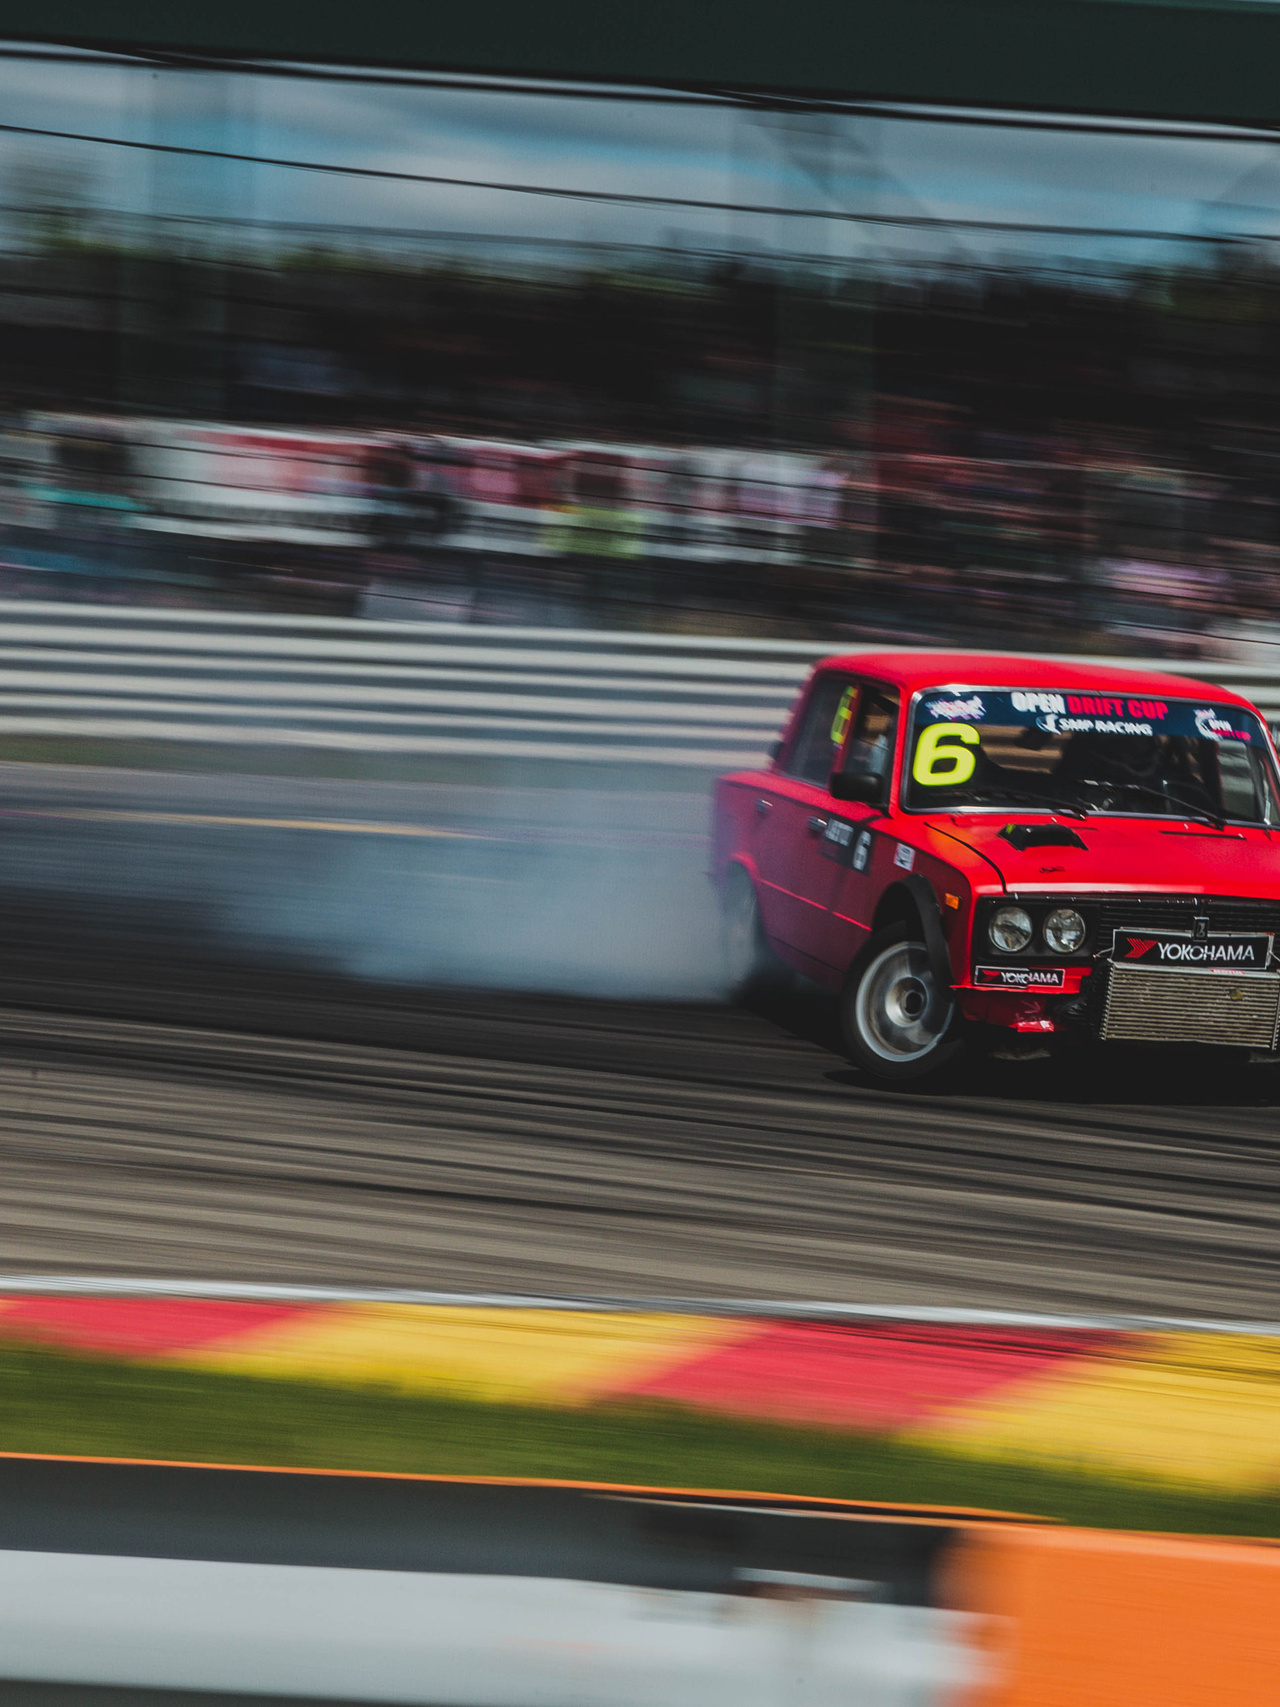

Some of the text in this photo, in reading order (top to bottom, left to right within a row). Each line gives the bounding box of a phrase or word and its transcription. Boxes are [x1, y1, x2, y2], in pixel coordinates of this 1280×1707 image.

[1011, 691, 1067, 715] OPEN
[1066, 695, 1124, 717] DRIFT
[1127, 699, 1169, 720] CUP
[1094, 720, 1153, 737] RACING
[912, 722, 980, 786] 6
[1157, 942, 1255, 961] YOKOHAMA
